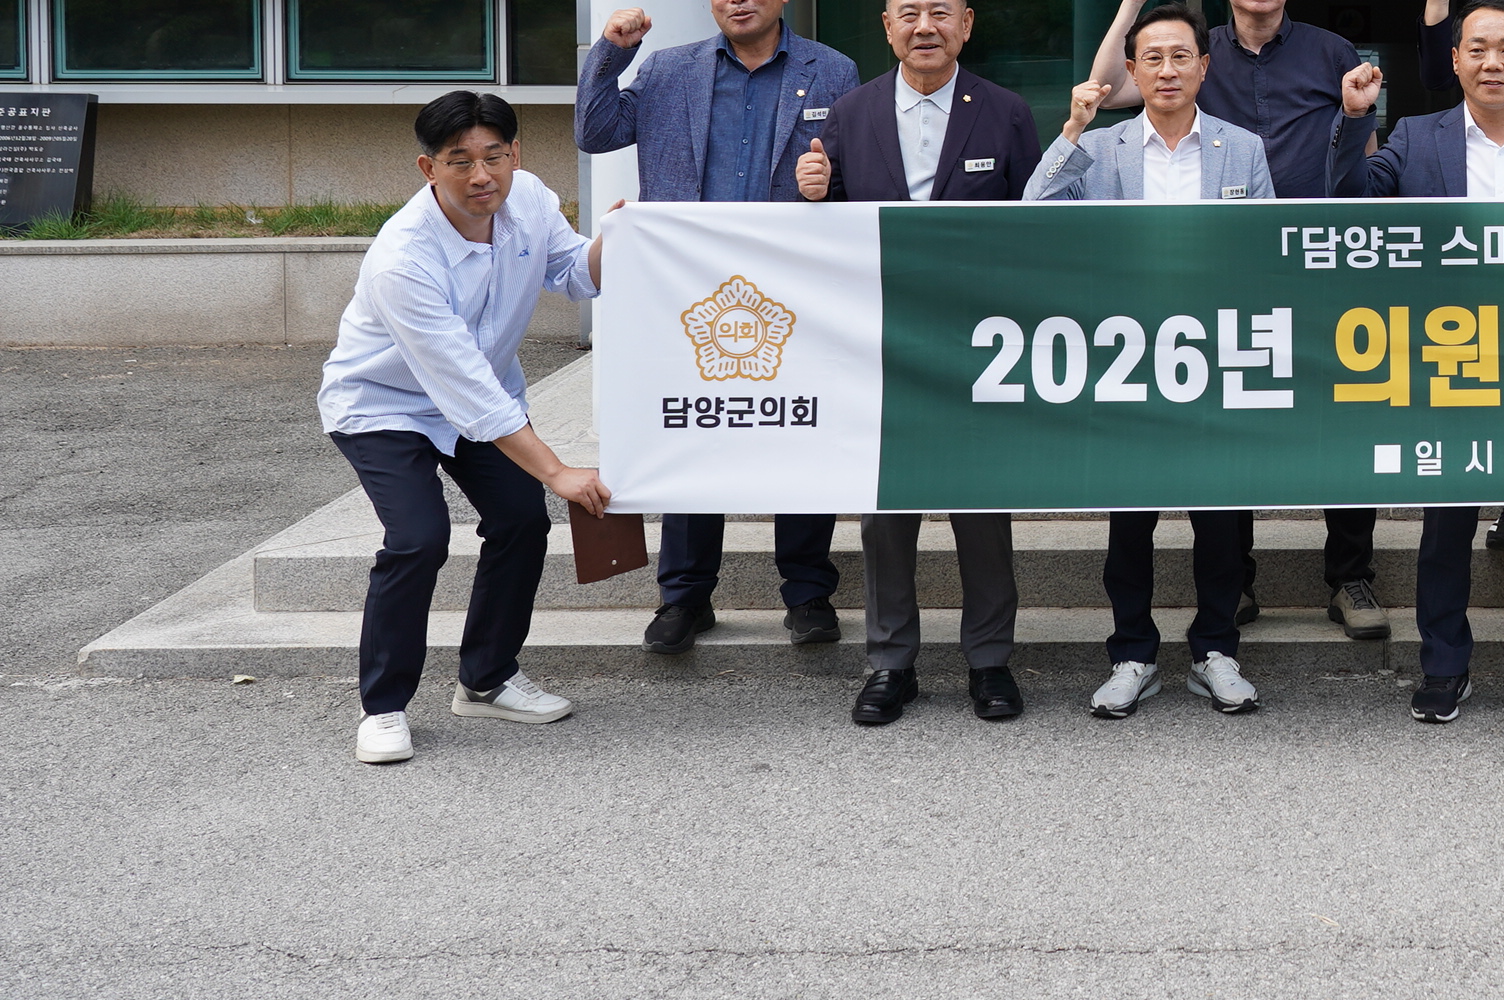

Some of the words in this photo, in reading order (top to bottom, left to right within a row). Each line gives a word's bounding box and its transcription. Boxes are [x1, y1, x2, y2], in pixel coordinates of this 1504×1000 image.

[1281, 226, 1424, 269] 「담양군
[717, 320, 758, 343] 의회
[971, 307, 1294, 410] 2026년
[662, 395, 818, 429] 담양군의회
